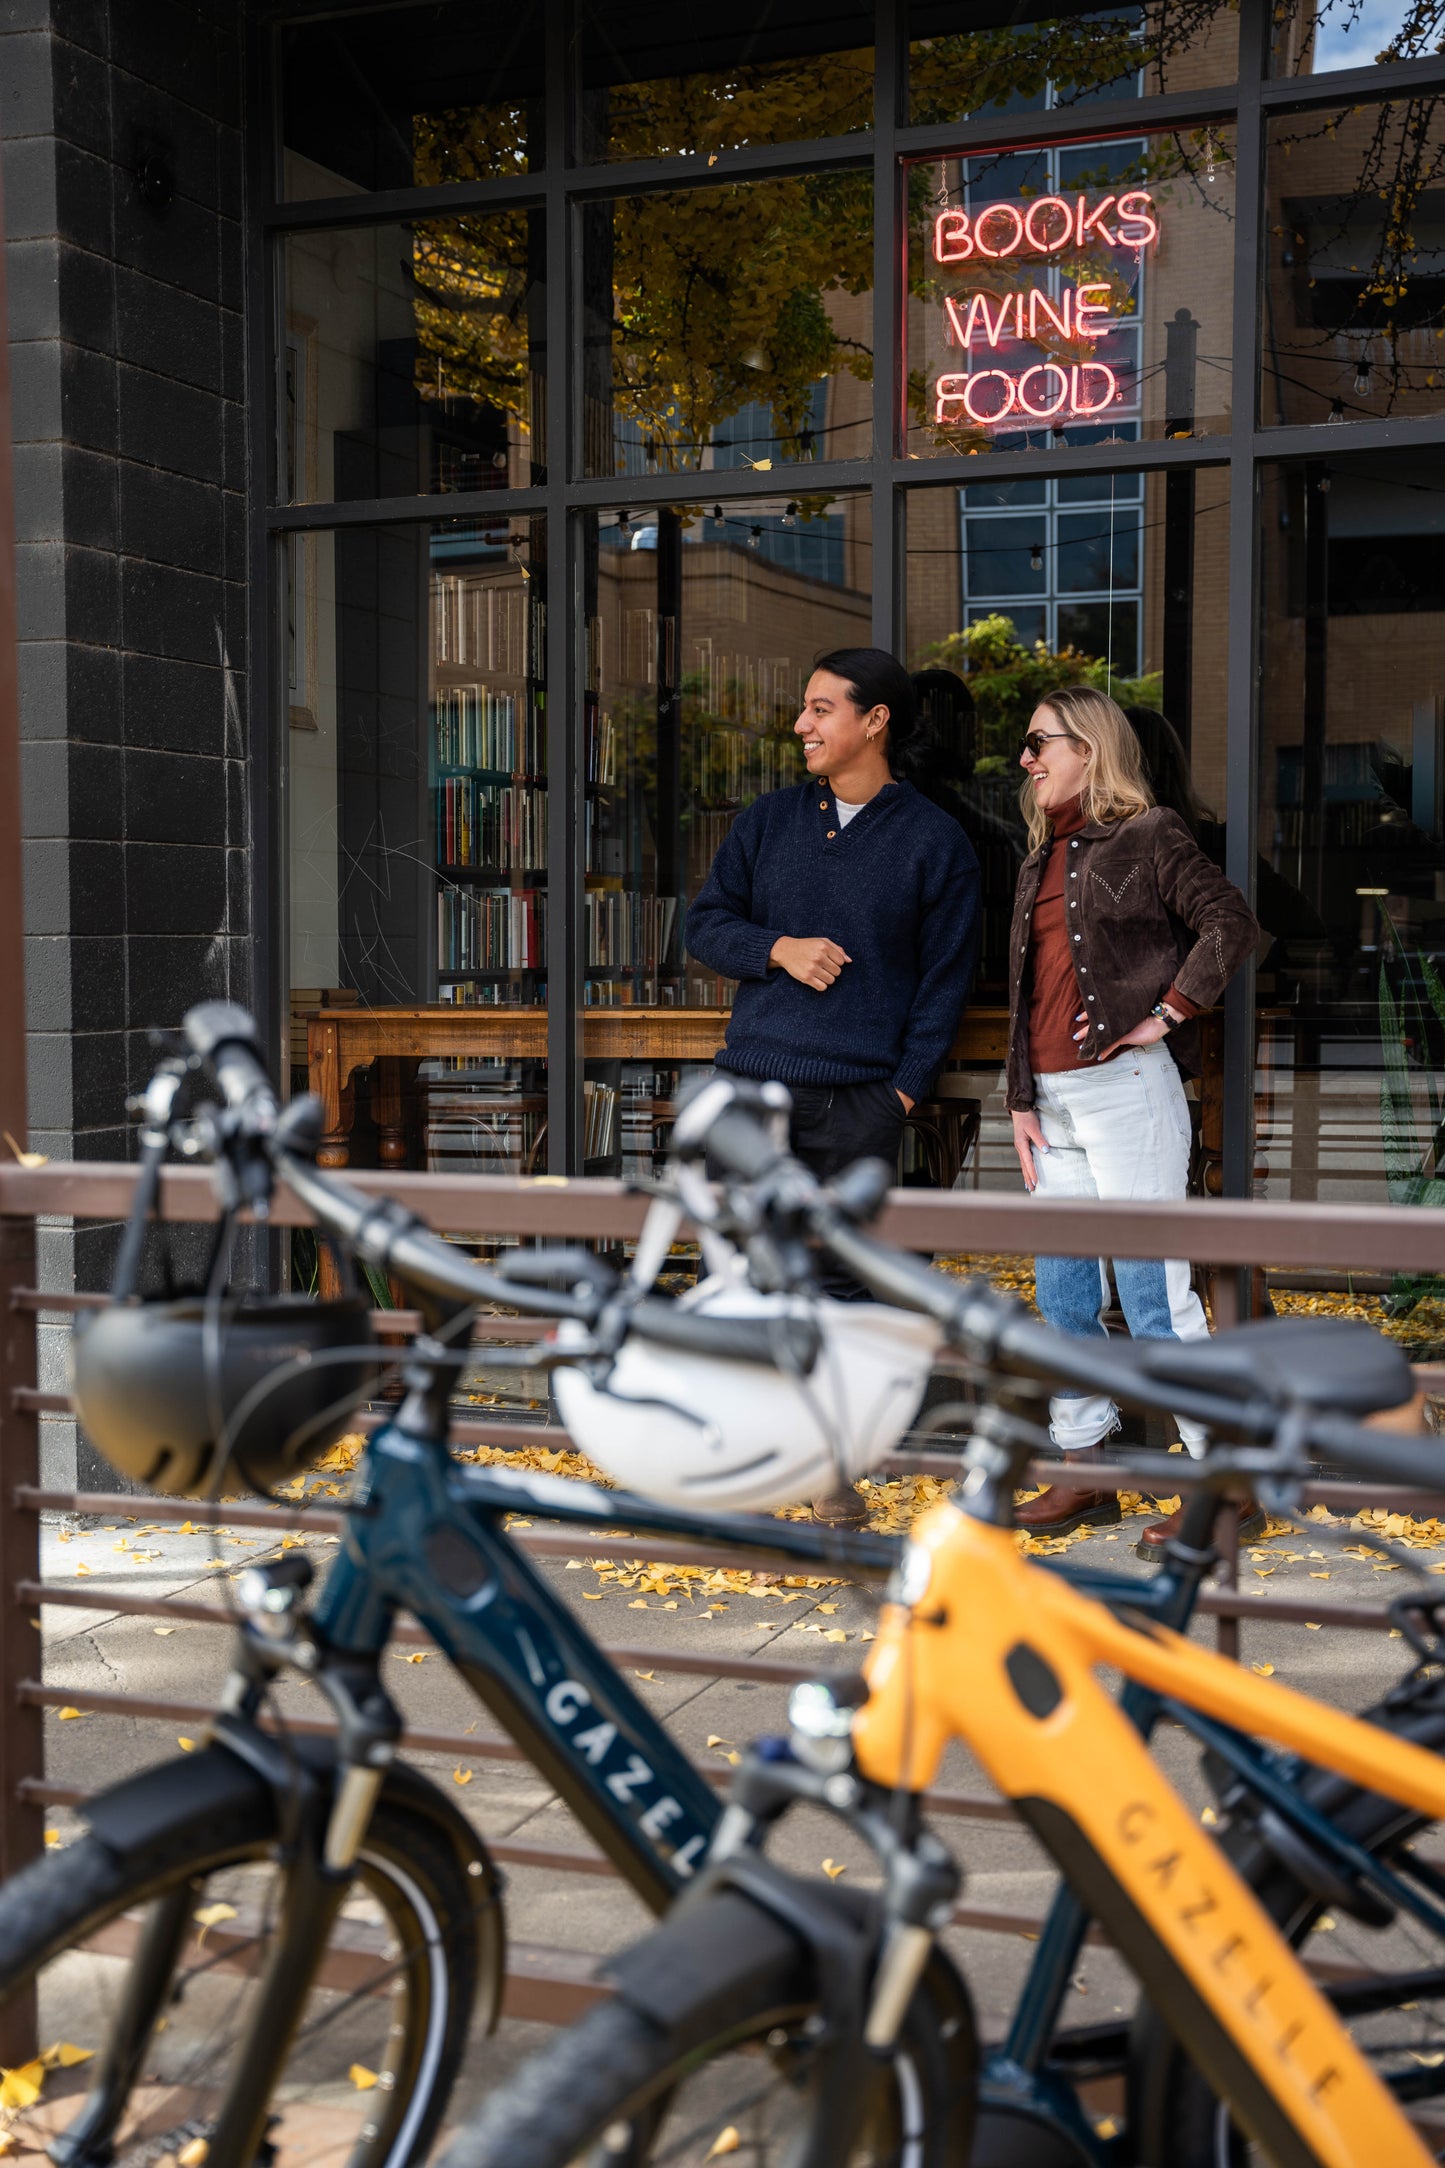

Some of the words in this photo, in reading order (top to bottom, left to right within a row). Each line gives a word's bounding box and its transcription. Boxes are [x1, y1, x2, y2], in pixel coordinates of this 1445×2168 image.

[935, 191, 1157, 262] BOOKS
[944, 283, 1112, 349] WINE
[935, 362, 1117, 425] FOOD
[545, 1680, 707, 1877] GAZEL
